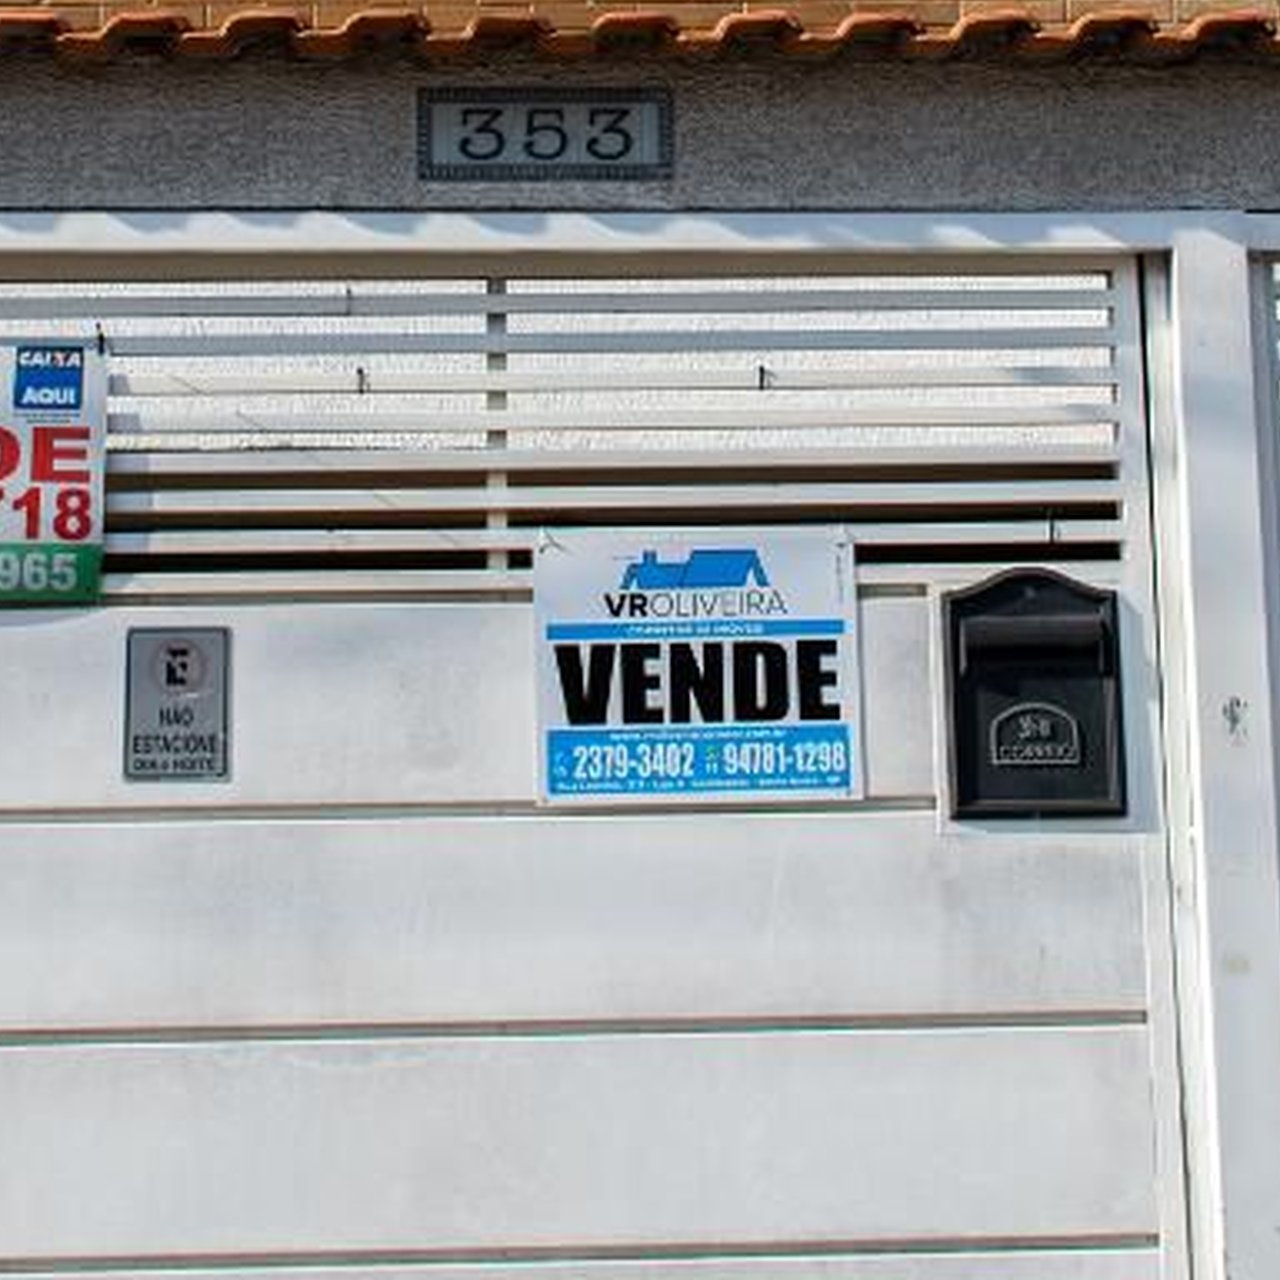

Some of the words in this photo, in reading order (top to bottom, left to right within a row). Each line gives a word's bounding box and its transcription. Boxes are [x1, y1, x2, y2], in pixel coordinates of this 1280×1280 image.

[459, 107, 633, 160] 353
[20, 350, 81, 367] CAIXA
[22, 389, 76, 405] AQUI
[604, 589, 788, 618] VROLIVEIRA
[554, 640, 841, 725] VENDE
[573, 742, 694, 779] 2379-3402
[723, 741, 846, 774] 94781-1298
